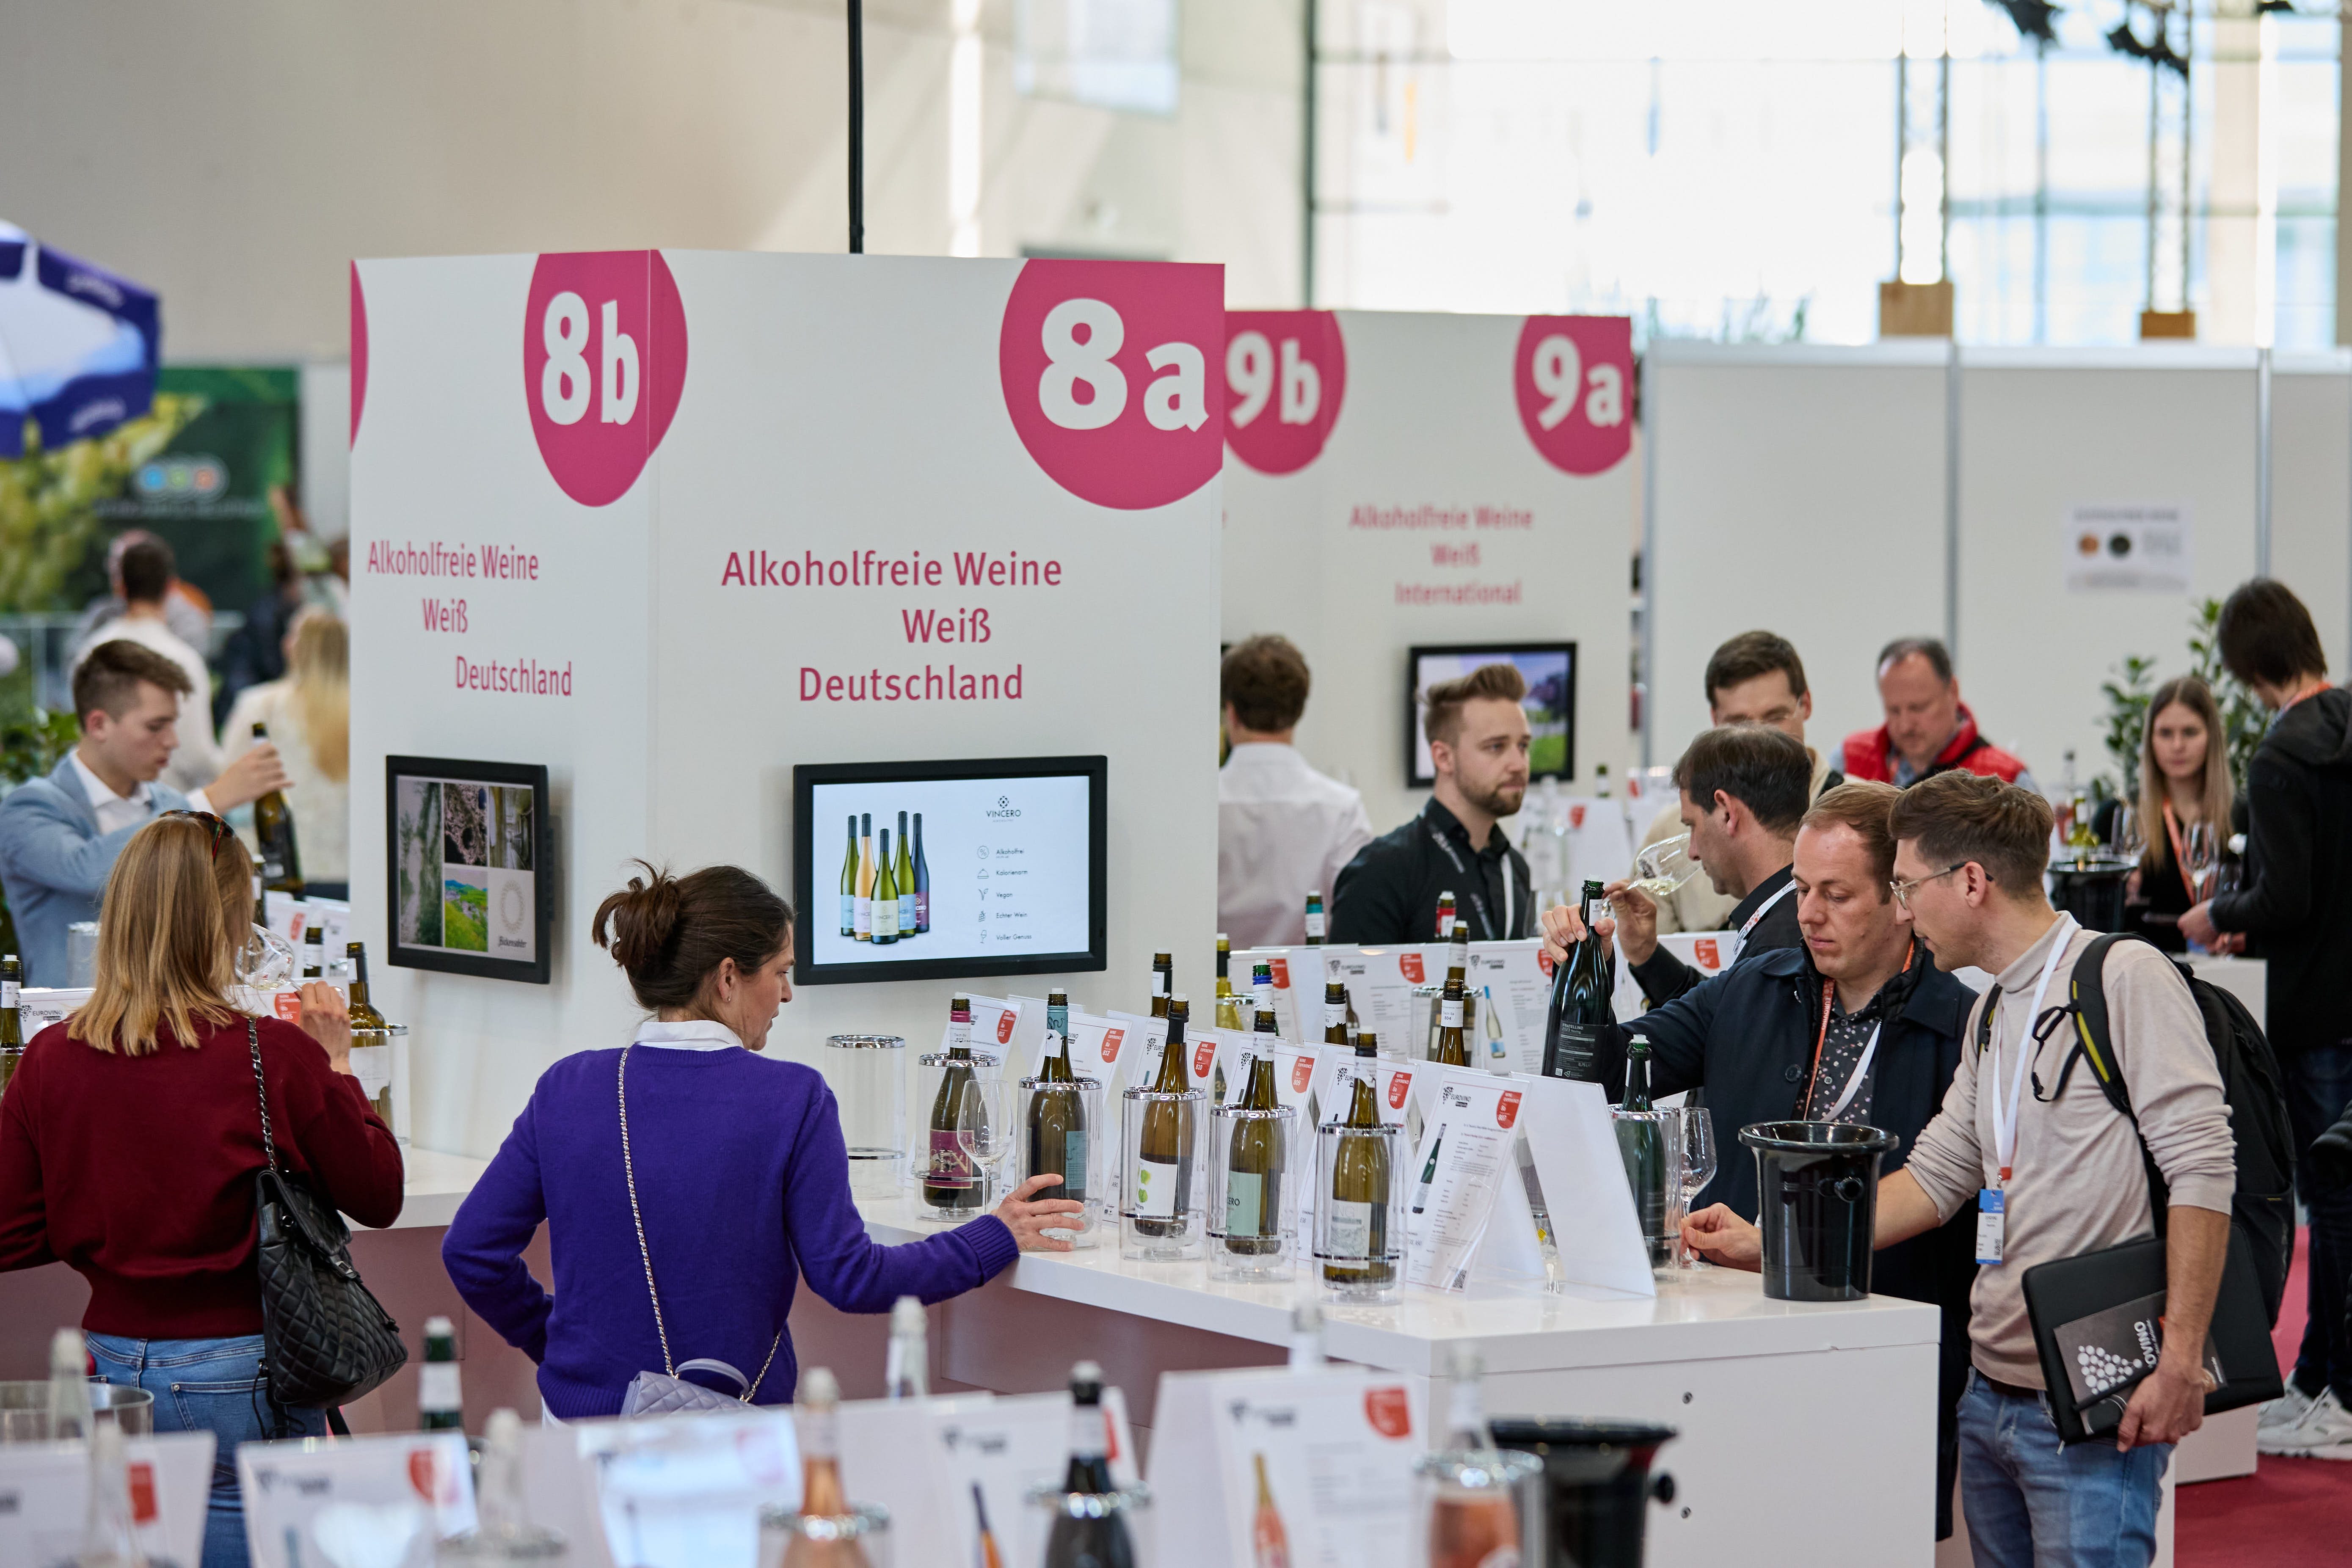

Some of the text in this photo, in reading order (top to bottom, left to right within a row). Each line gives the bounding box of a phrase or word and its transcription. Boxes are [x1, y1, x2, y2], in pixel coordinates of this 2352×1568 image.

[542, 291, 640, 425] 8b
[1039, 298, 1209, 432] 8a
[1225, 330, 1322, 429] 9b
[1532, 333, 1623, 431] 9a
[1349, 505, 1534, 529] Alkoholfreie Weine
[368, 540, 539, 580] Alkoholfreie Weine
[722, 550, 1062, 587] Alkoholfreie Weine
[1431, 542, 1481, 567] Weiß
[1395, 580, 1523, 605] International
[422, 598, 468, 634] Weiß
[902, 608, 991, 643] Weiß
[456, 656, 571, 696] Deutschland
[800, 664, 1023, 701] Deutschland
[986, 810, 1021, 818] VINCERO
[2134, 1321, 2157, 1365] OVINO
